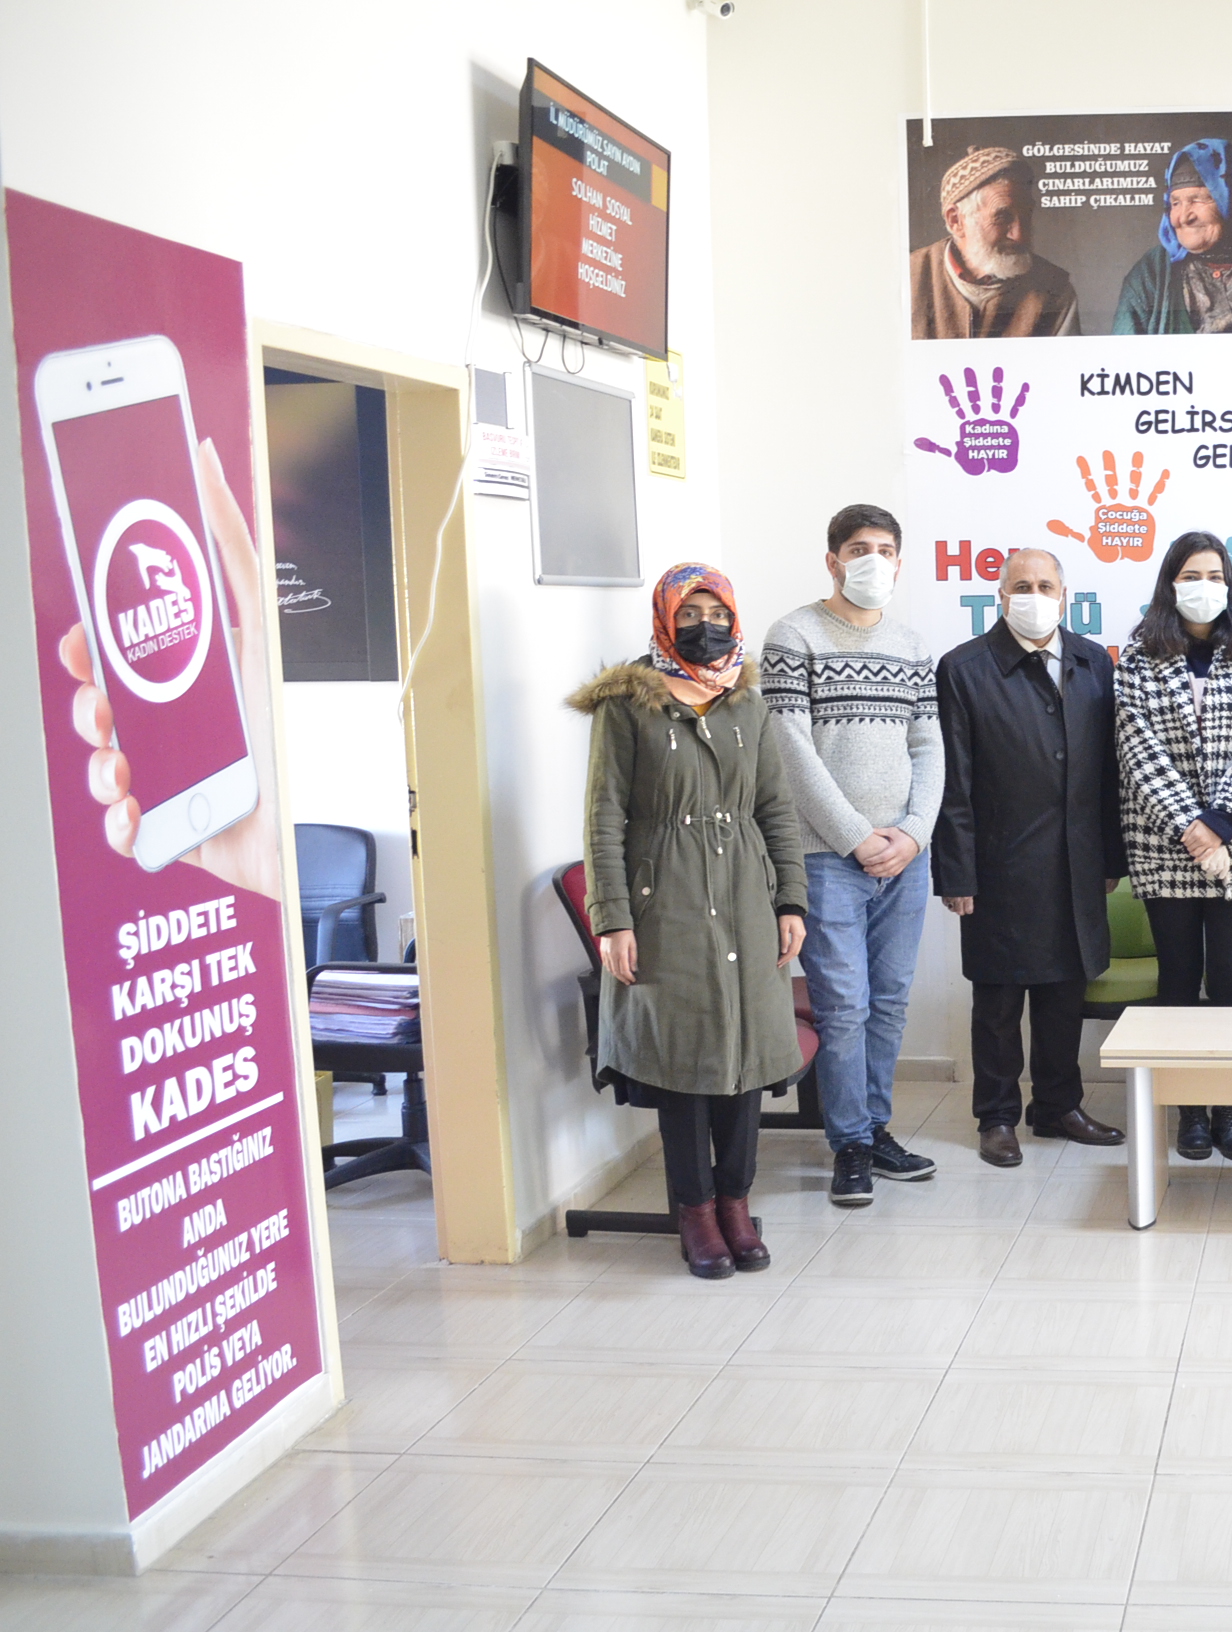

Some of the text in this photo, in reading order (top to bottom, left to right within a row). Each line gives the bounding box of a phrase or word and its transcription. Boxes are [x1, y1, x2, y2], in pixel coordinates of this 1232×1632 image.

[549, 102, 641, 175] İL MÜDÜRÜMÜZ SAYIN AYDIN
[1022, 141, 1172, 157] GÖLGESİNDE HAYAT
[586, 151, 609, 175] POLAT
[1045, 158, 1149, 173] BULDUĞUMUZ
[571, 177, 633, 225] SOLHAN SOSYAL
[1038, 177, 1157, 193] ÇINARLARIMIZA
[1041, 193, 1154, 209] SAHİP ÇIKALIM
[589, 212, 617, 241] HİZMET
[581, 237, 623, 271] MERKEZİNE
[578, 262, 626, 297] HOŞGELDİNİZ
[1080, 367, 1194, 397] KİMDEN
[962, 436, 1013, 449] Şiddete
[964, 423, 1009, 434] Kadına
[967, 449, 1009, 460] HAYIR
[1097, 521, 1149, 534] Şiddete
[1098, 508, 1149, 522] Çocuğa
[1101, 535, 1144, 547] HAYIR
[934, 540, 1021, 581] He
[117, 592, 195, 648] KADES
[126, 621, 199, 664] KADIN DESTEK
[118, 895, 238, 970] ŞİDDETE
[111, 941, 257, 1021] KARŞI TEK
[120, 993, 257, 1075] DOKUNUŞ
[130, 1045, 259, 1142] KADES
[117, 1125, 274, 1233] BUTONA BASTIĞINIZ
[182, 1198, 228, 1249] ANDA
[117, 1208, 290, 1338] BULUNDUĞUNUZ YERE
[143, 1260, 278, 1374] EN HIZLI ŞEKİLDE
[173, 1319, 263, 1403] POLİS VEYA
[140, 1343, 297, 1479] JANDARMA GELİYOR.
